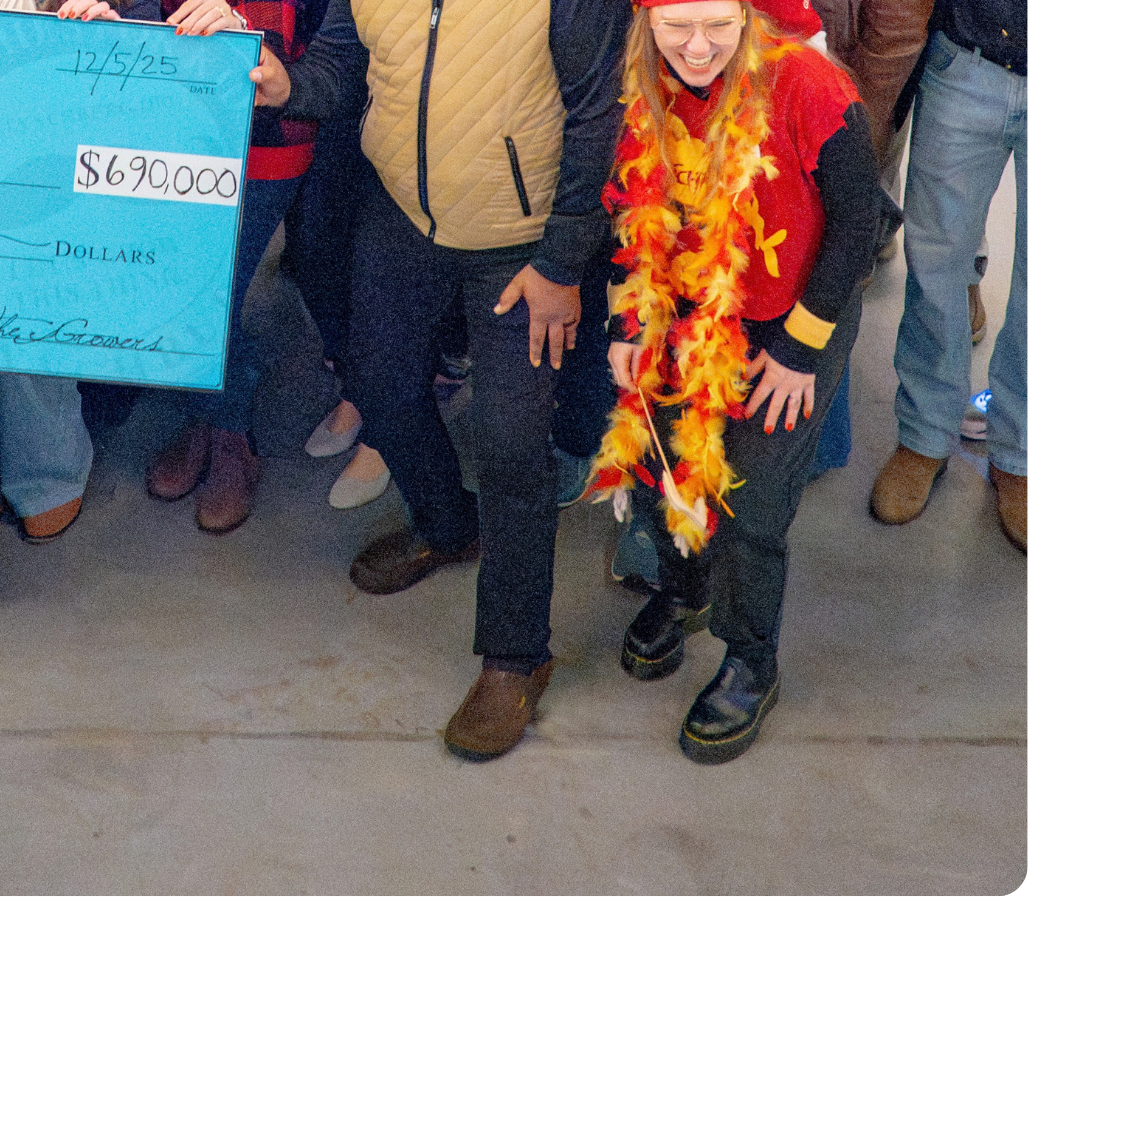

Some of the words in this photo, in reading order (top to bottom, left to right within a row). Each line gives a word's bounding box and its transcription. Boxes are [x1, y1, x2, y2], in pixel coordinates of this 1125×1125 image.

[75, 40, 179, 96] 12/5/25
[189, 86, 217, 95] DATE
[77, 149, 237, 198] $690,000
[55, 240, 155, 265] DOLLARS
